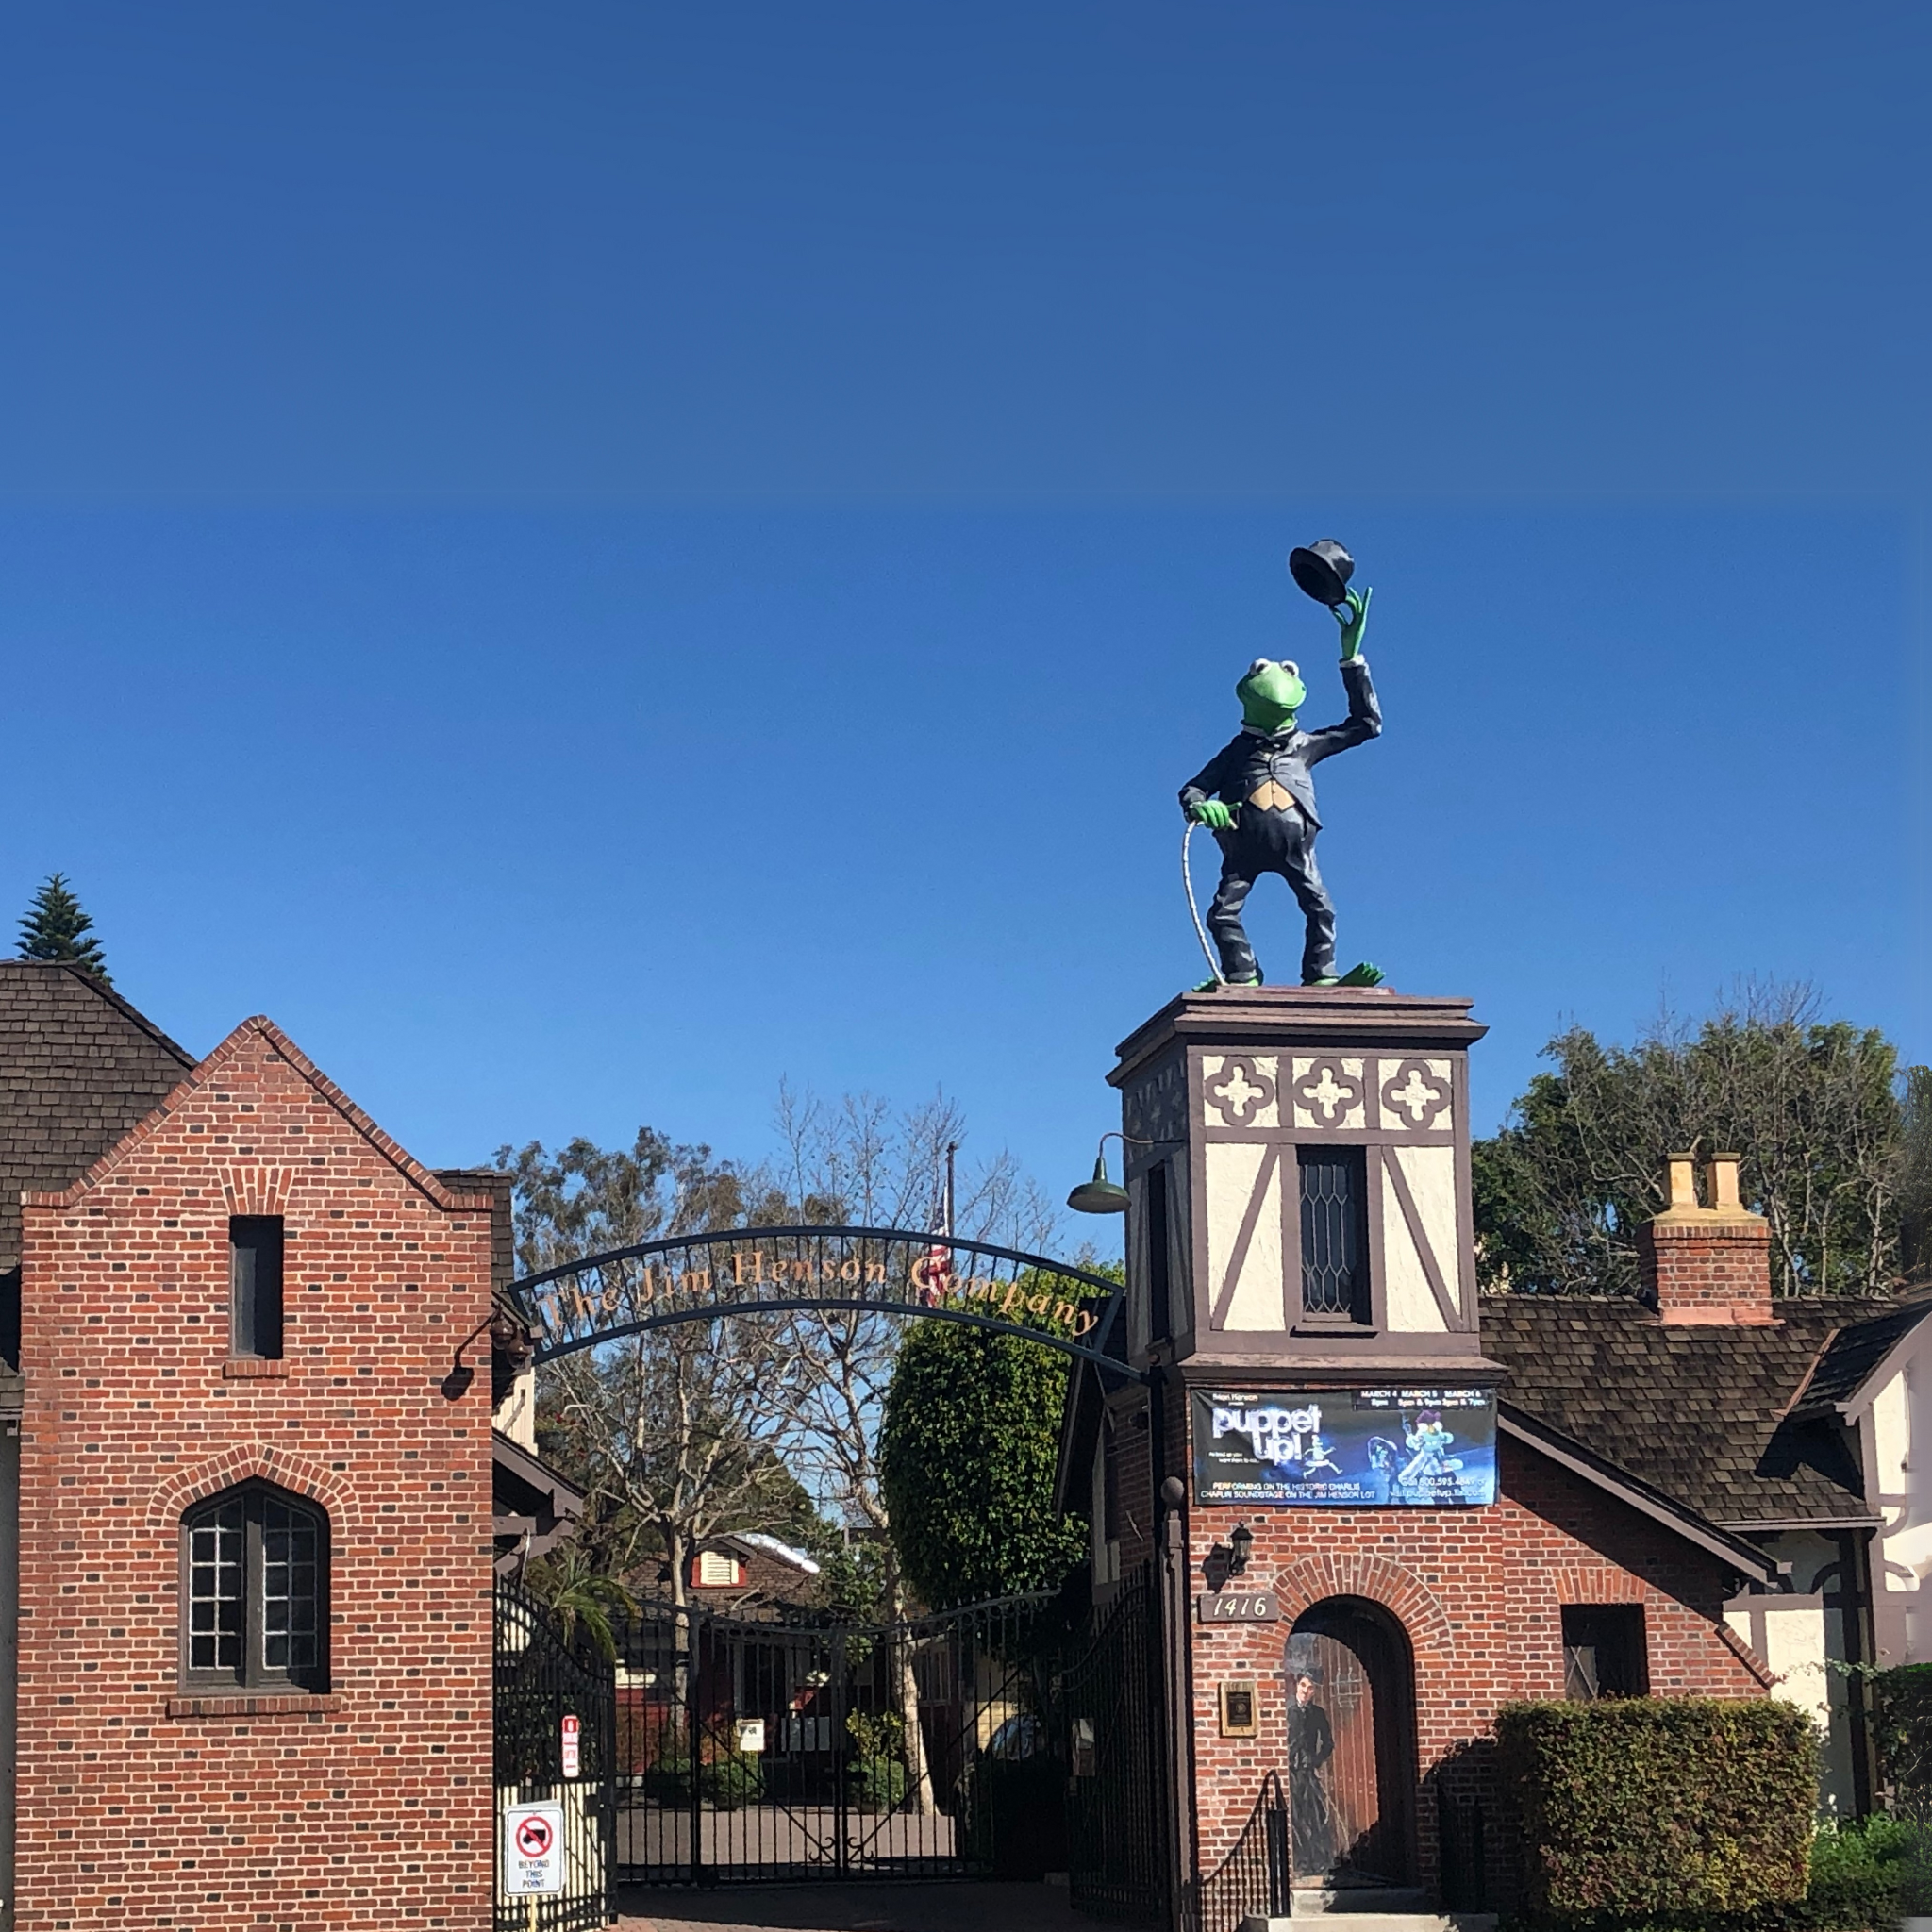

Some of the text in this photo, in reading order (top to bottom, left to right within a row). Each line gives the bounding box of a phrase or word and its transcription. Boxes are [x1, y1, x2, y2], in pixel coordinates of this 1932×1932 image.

[537, 1250, 1099, 1337] The Jim Henson Company
[1212, 1404, 1322, 1439] puppet
[1252, 1432, 1302, 1466] up!
[1213, 1482, 1262, 1491] PERFORMING
[1264, 1482, 1275, 1491] ON
[1276, 1482, 1291, 1491] THE
[1291, 1482, 1327, 1491] HISTORIC
[1200, 1491, 1374, 1499] CHAPLIN SOUNDSTAGE ON THE JIM HENSON LOT
[1213, 1597, 1267, 1617] 1416
[518, 1860, 550, 1870] BEYOND
[525, 1870, 543, 1878] THIS
[522, 1879, 545, 1889] POINT
